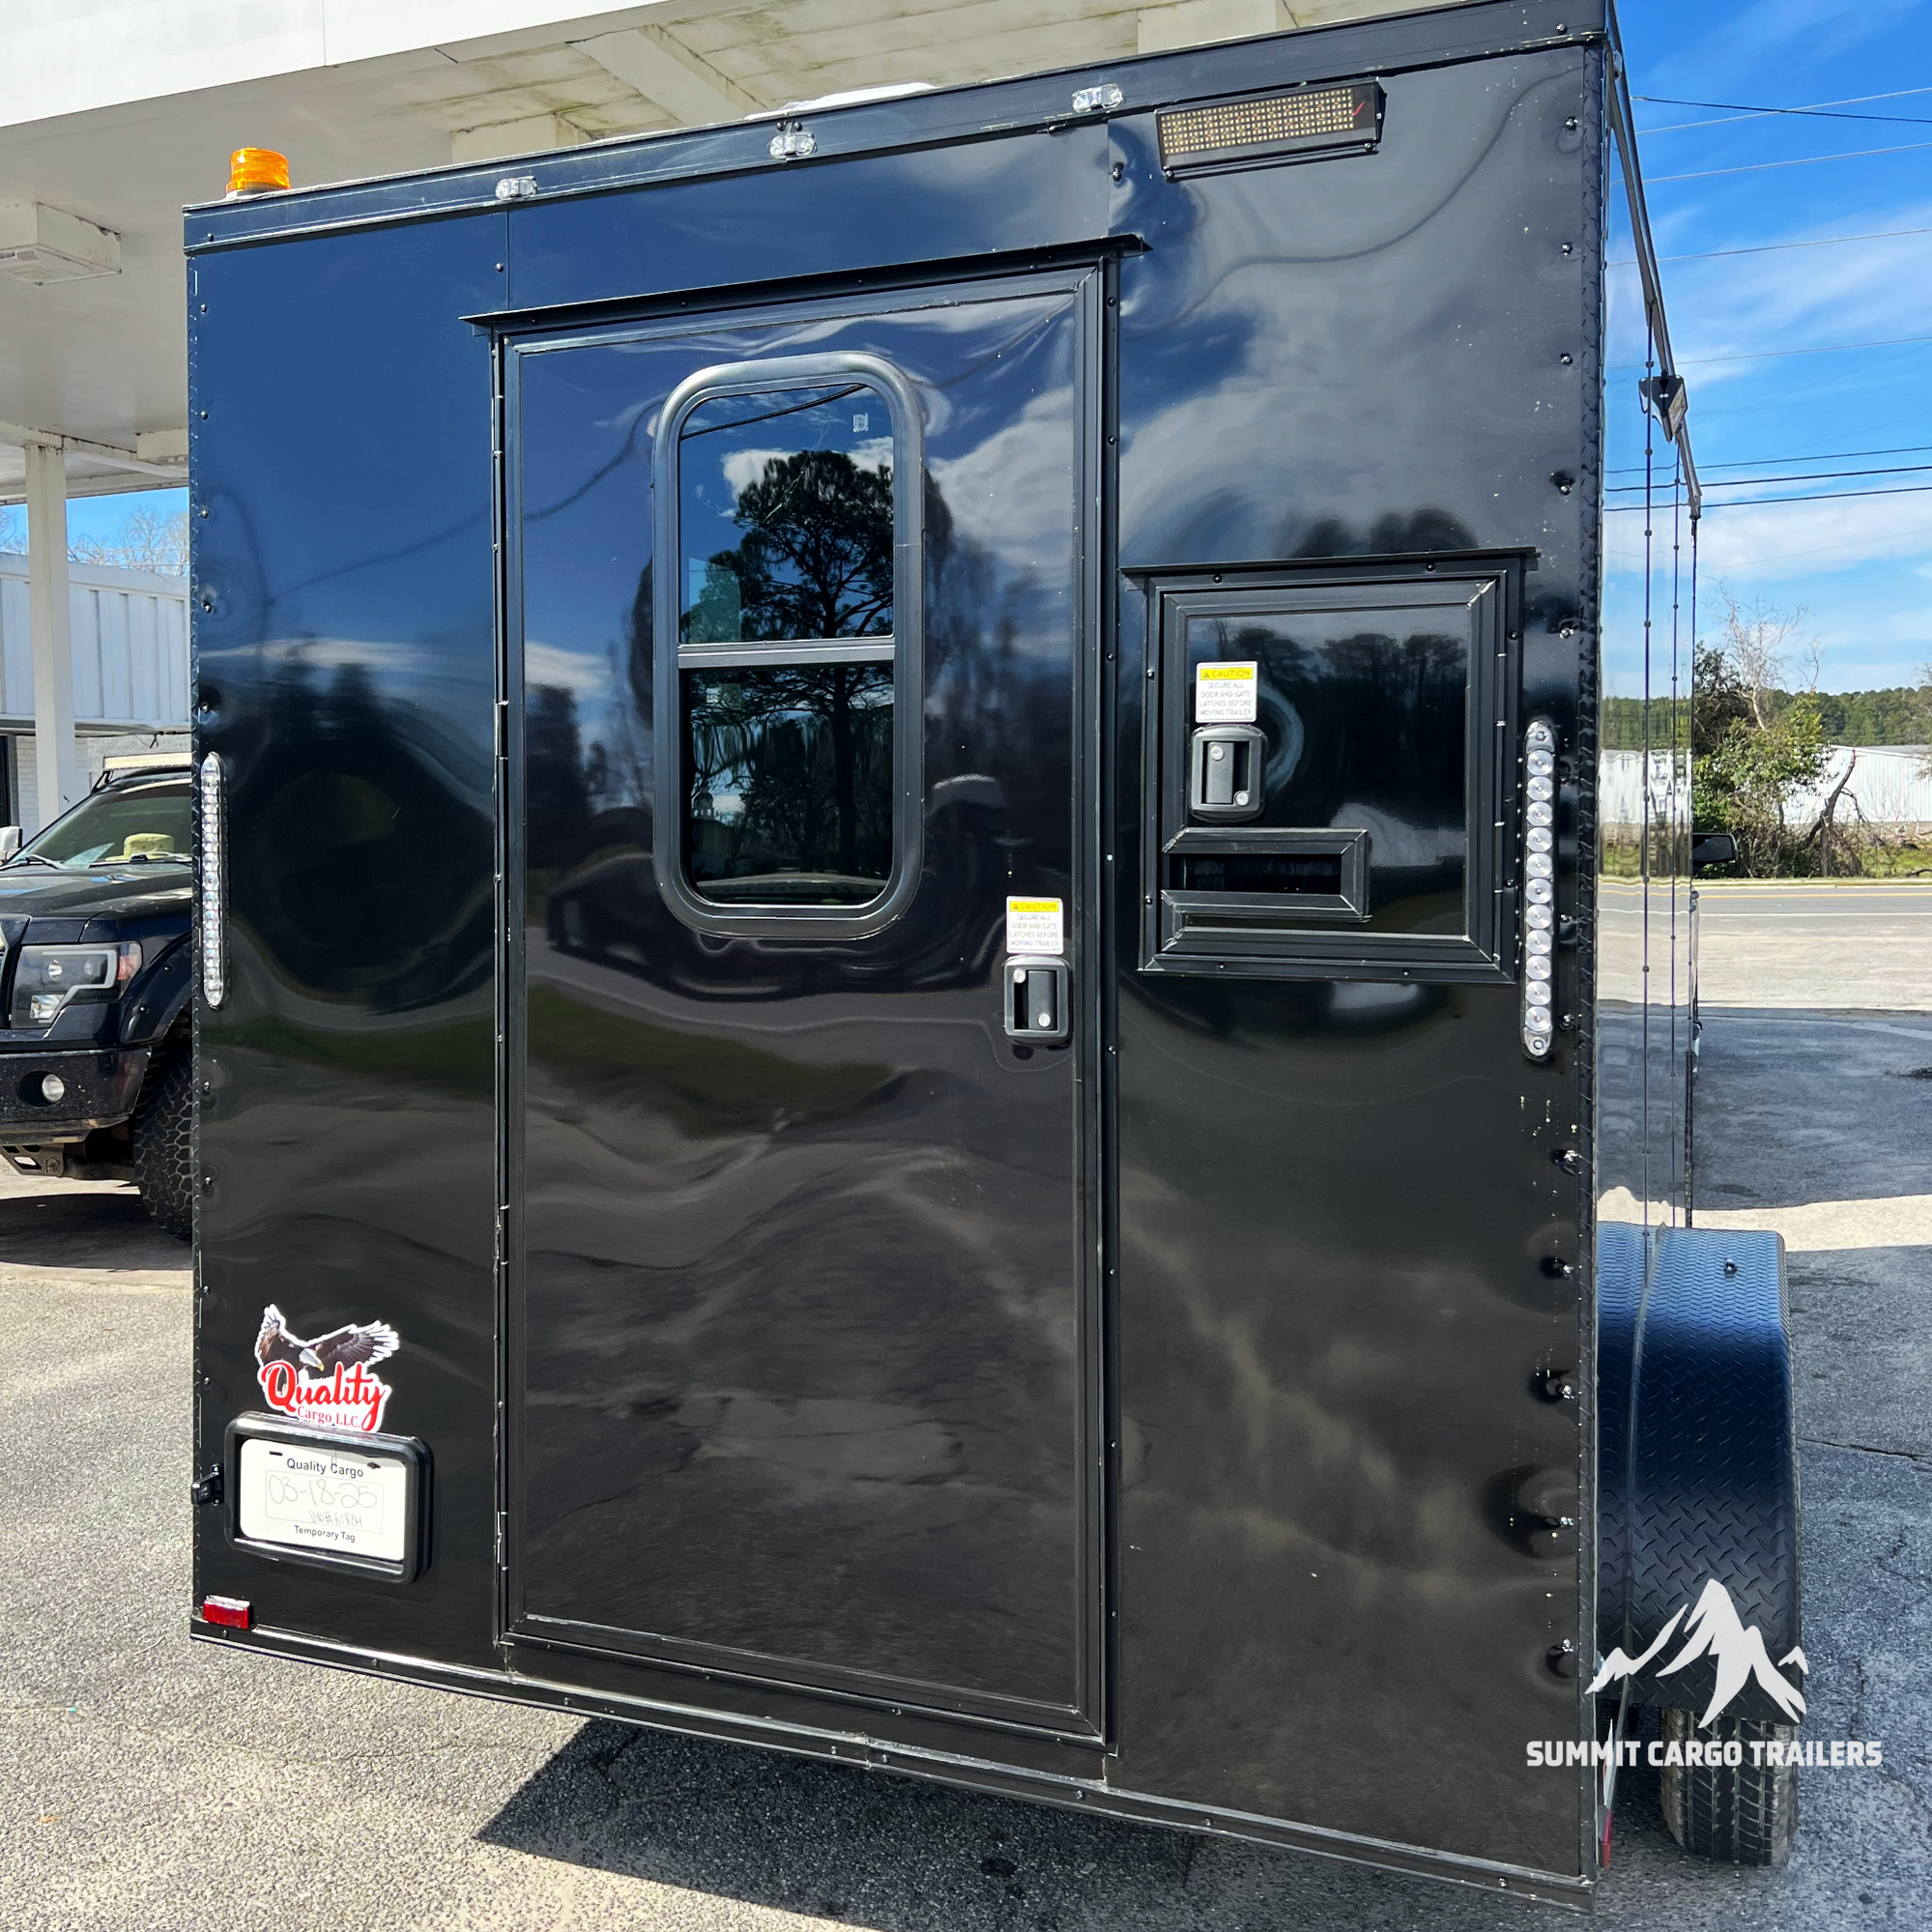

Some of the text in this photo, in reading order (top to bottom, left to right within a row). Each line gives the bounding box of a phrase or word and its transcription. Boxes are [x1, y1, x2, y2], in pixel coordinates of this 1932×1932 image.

[1211, 669, 1251, 678] CAUTION
[1020, 902, 1056, 910] CAUTION
[261, 1361, 388, 1431] Quality
[297, 1405, 361, 1428] Cargo LLC.
[286, 1457, 364, 1479] Quality Cargo
[268, 1474, 378, 1509] 03-18-25
[293, 1524, 356, 1543] Temporary Tag
